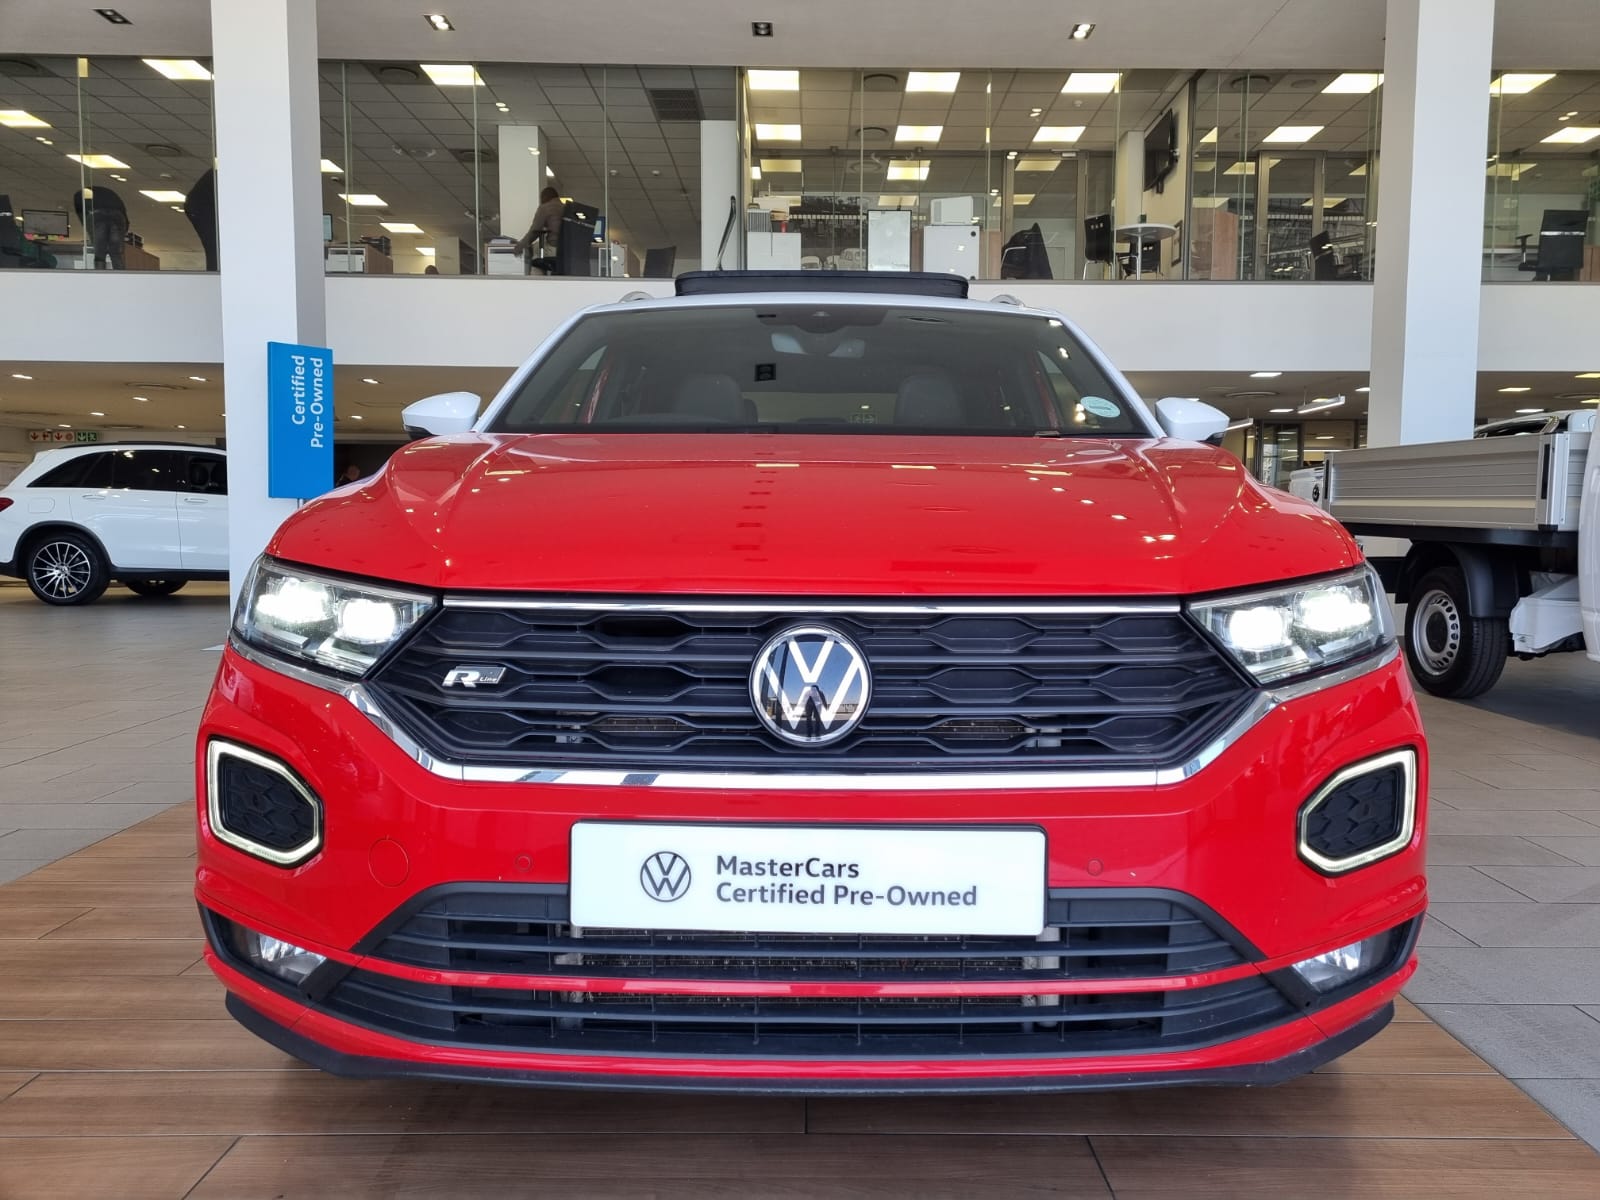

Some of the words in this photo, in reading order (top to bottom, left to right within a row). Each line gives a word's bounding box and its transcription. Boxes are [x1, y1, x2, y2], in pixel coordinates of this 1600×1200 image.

[291, 355, 305, 425] Certified
[310, 357, 324, 448] Pre-Owned
[754, 628, 868, 741] VW
[640, 851, 691, 902] VW
[716, 855, 859, 878] MasterCars
[716, 881, 825, 905] Certified
[834, 884, 977, 906] Pre-Owned
